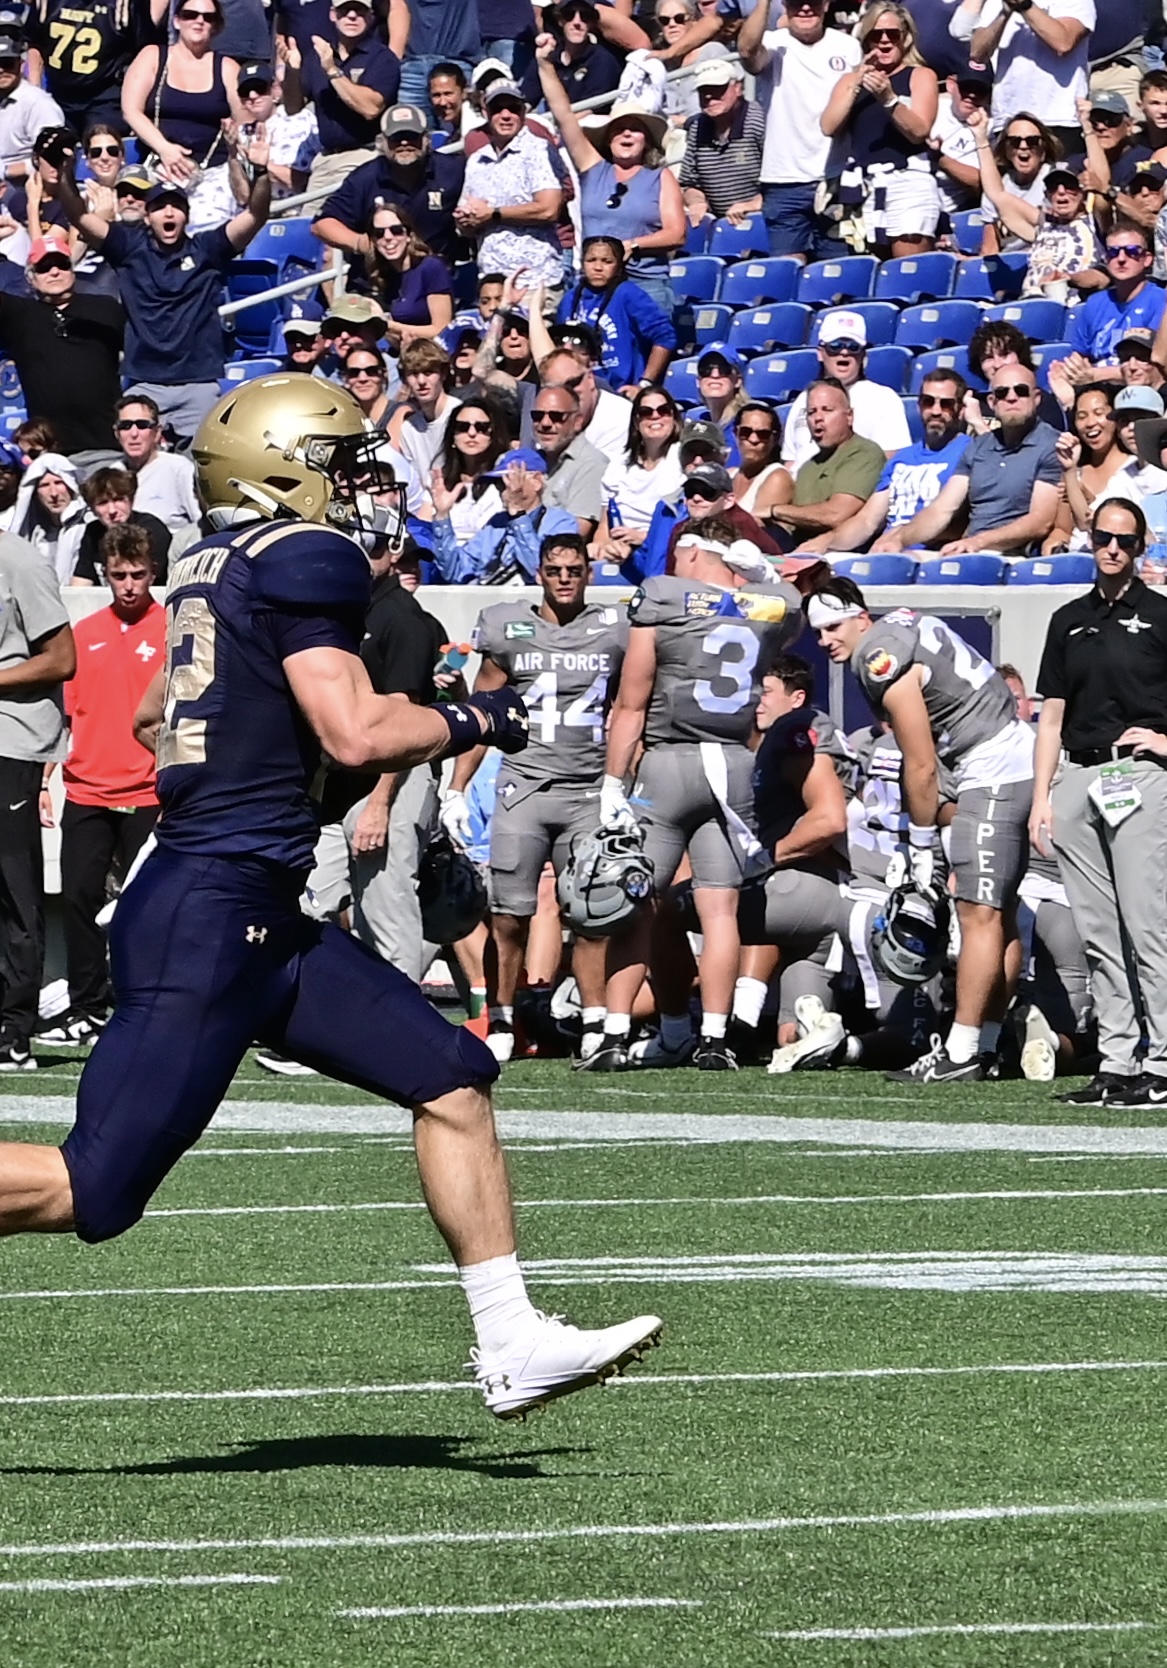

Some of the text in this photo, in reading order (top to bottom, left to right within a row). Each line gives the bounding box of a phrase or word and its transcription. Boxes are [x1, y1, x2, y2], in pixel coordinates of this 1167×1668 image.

[48, 22, 102, 74] 72
[514, 652, 610, 673] AIR FORCE
[694, 624, 760, 713] 3
[522, 672, 609, 743] 44
